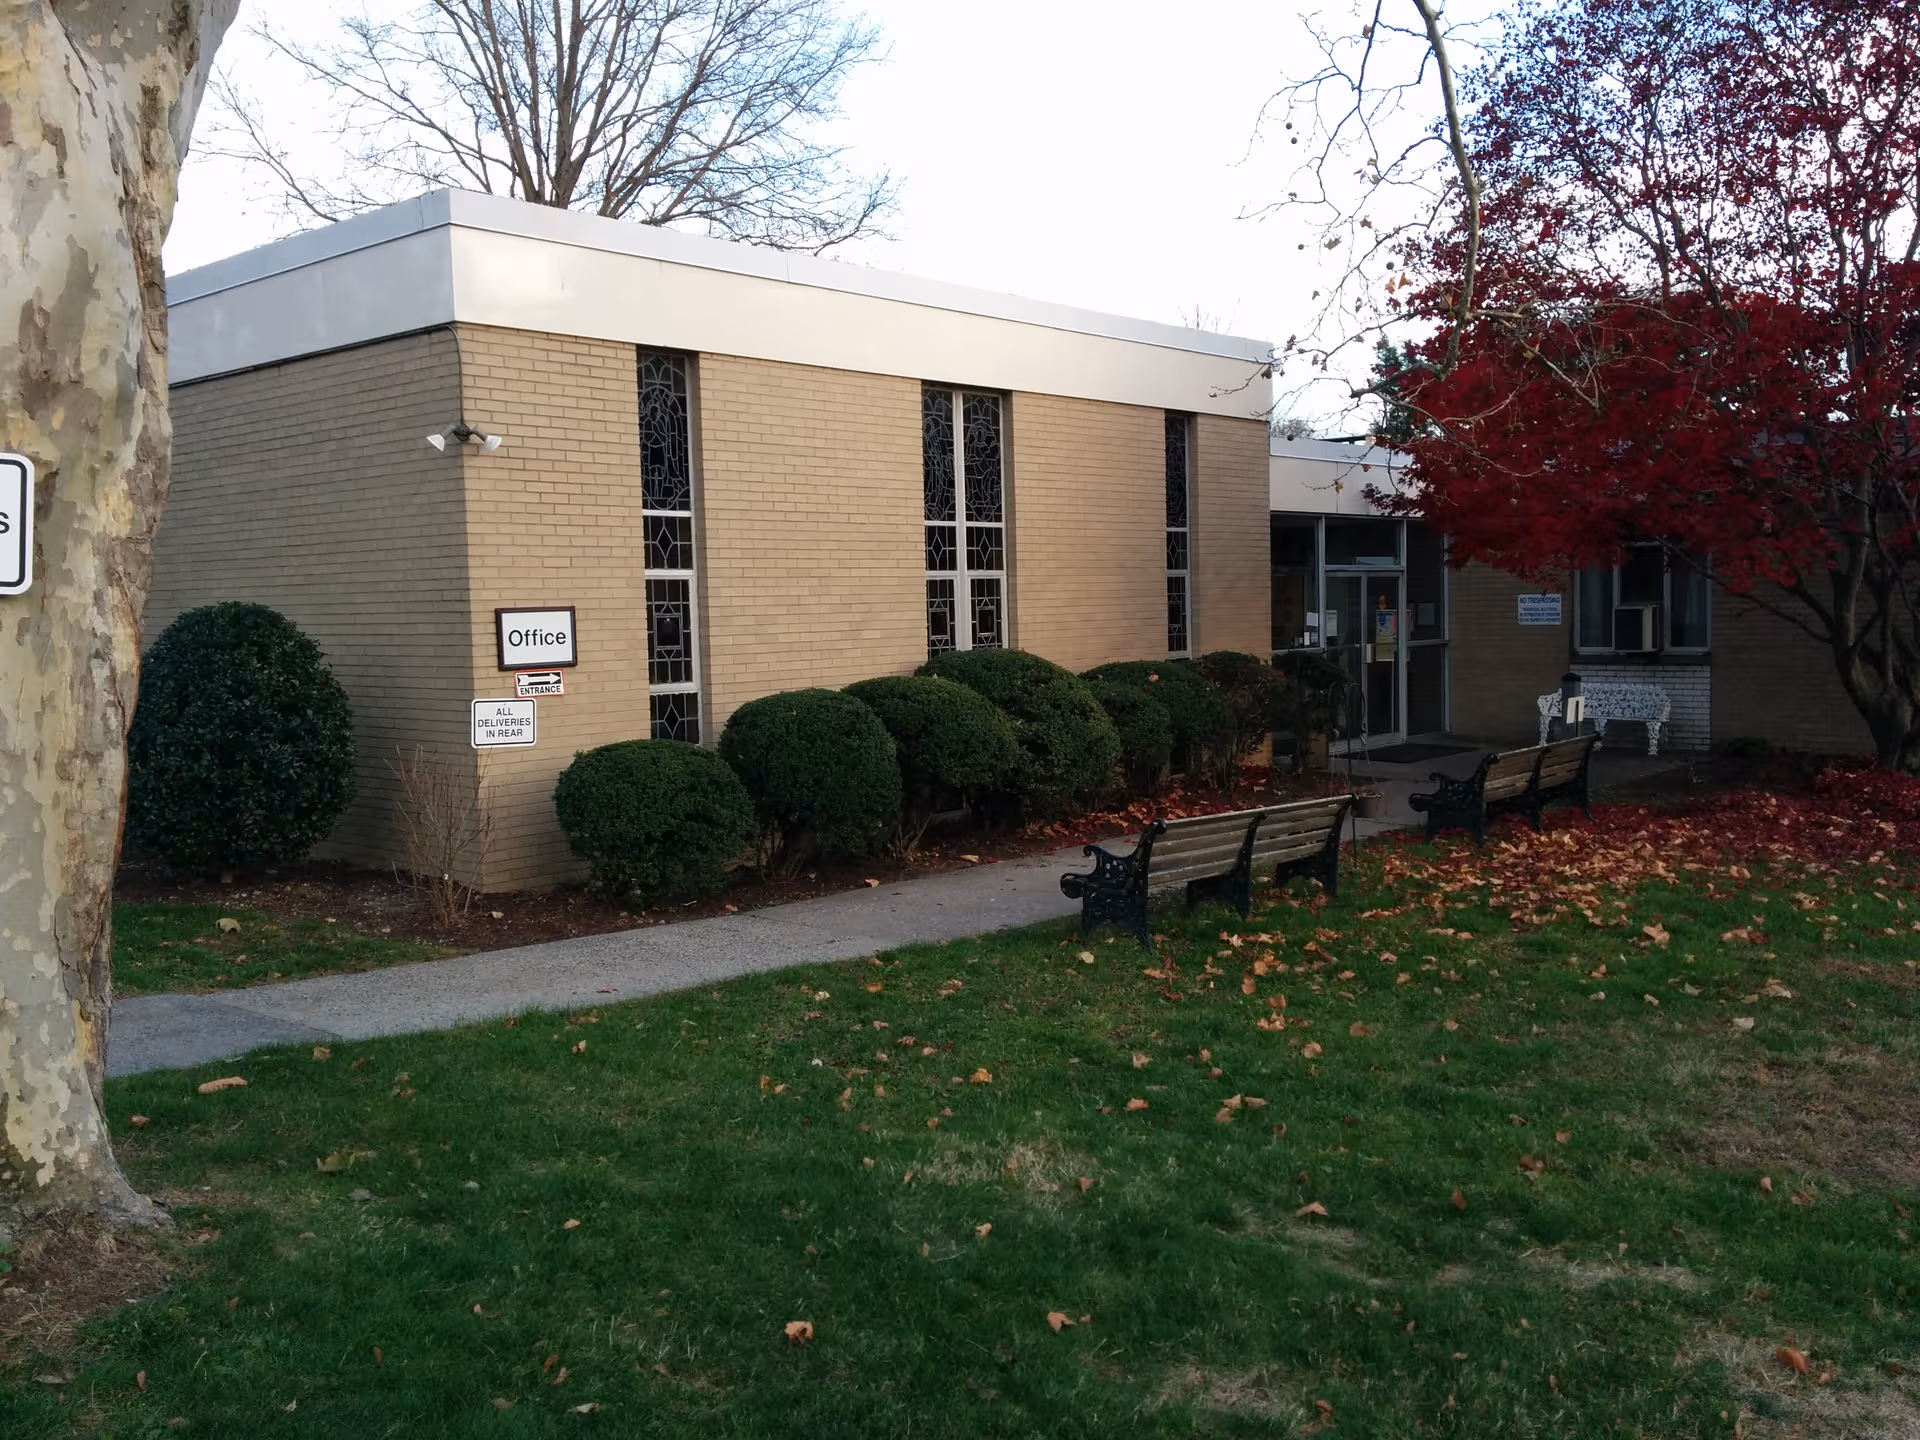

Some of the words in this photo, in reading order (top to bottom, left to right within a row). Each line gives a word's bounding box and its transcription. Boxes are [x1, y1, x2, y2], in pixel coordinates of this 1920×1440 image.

[508, 628, 567, 647] Office
[520, 685, 562, 696] ENTRANCE
[495, 707, 514, 716] ALL
[477, 717, 532, 728] DELIVERIES
[486, 729, 495, 738] IN
[497, 728, 523, 738] REAR
